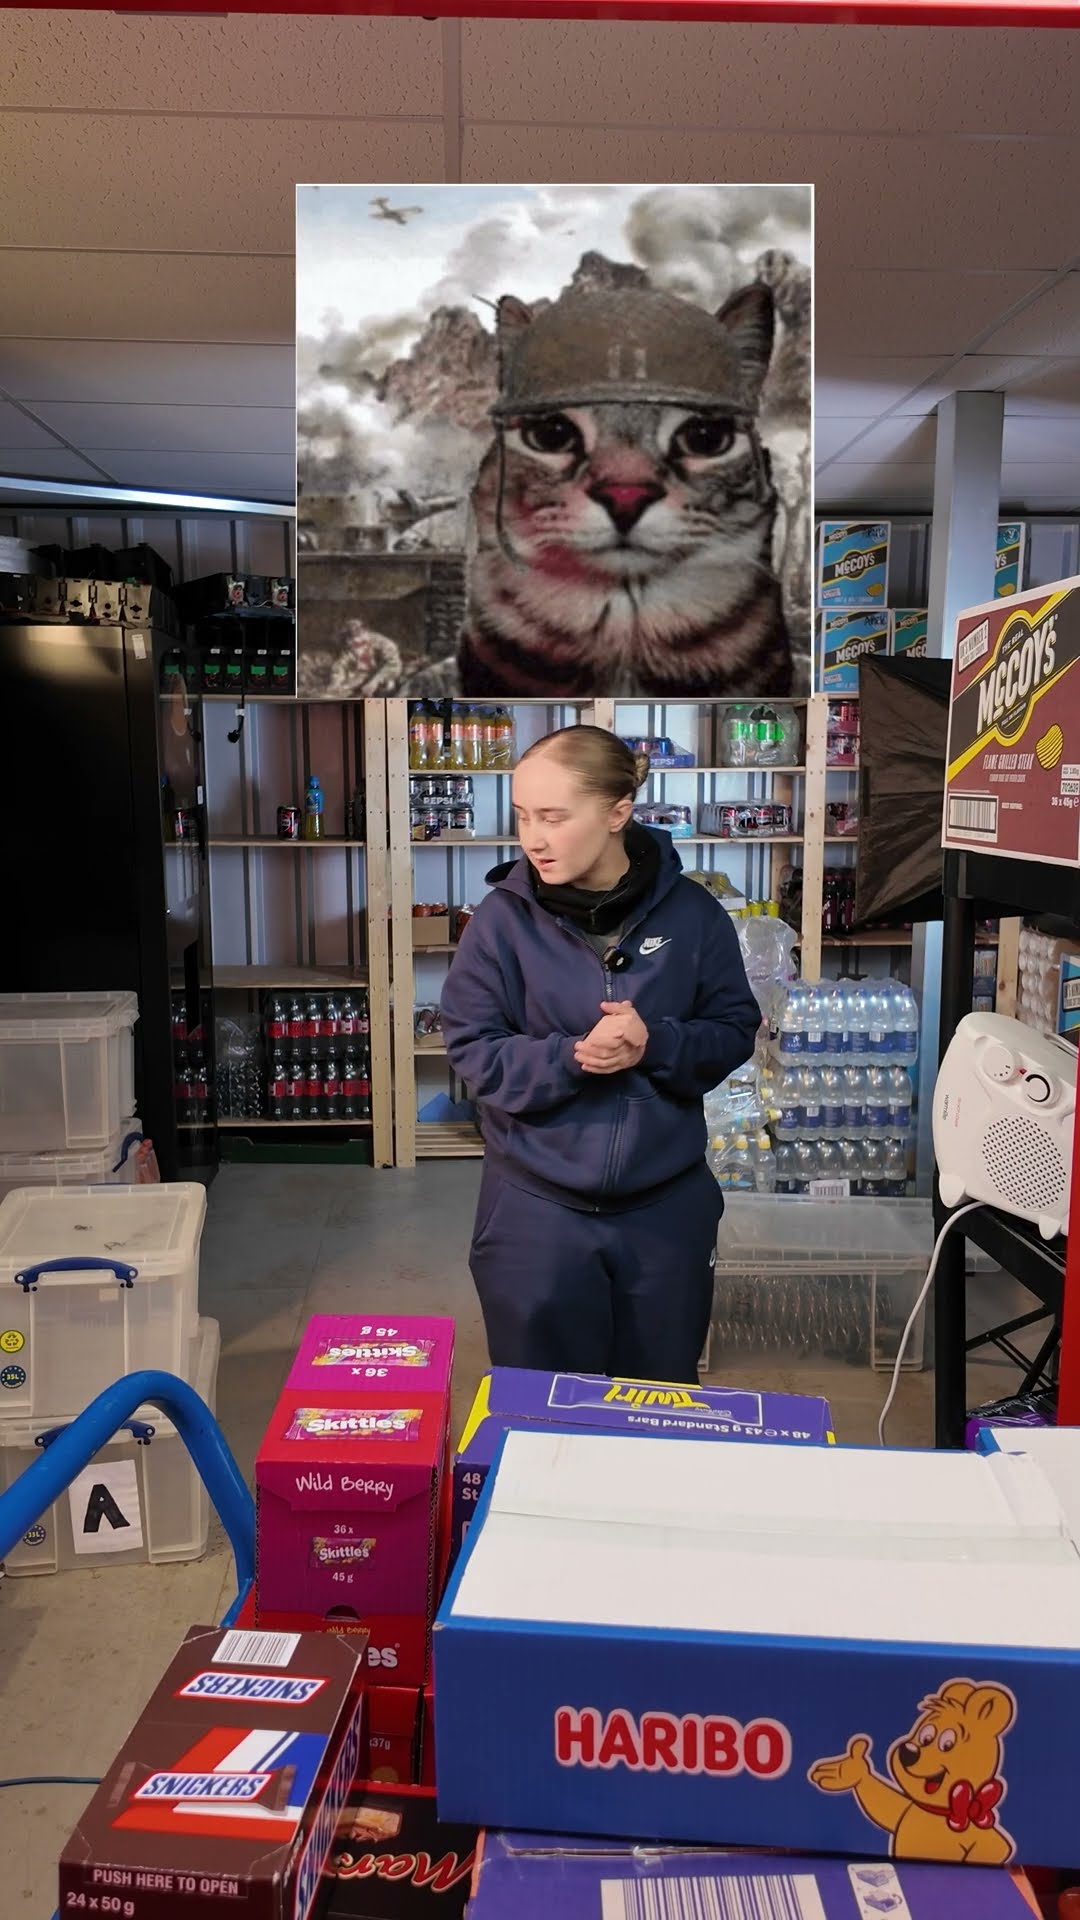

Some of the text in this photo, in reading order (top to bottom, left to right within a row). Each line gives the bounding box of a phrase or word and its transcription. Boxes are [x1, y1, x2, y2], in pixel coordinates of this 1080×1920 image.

[1002, 629, 1024, 655] THE REAL
[982, 754, 1034, 770] FLAME GRILLED STEAK
[423, 797, 453, 805] PEPSI
[643, 936, 663, 948] NIKE
[360, 1326, 398, 1337] 45 g
[329, 1346, 418, 1358] Skittles
[365, 1368, 388, 1377] 36
[603, 1384, 711, 1409] Twirl
[306, 1417, 406, 1433] Skittles
[627, 1415, 660, 1427] Bars
[662, 1418, 730, 1434] Standard
[732, 1425, 742, 1433] g
[780, 1429, 790, 1437] x
[792, 1431, 811, 1439] 48
[296, 1472, 332, 1492] Wild
[462, 1472, 481, 1485] 48
[83, 1484, 131, 1533] A
[334, 1524, 346, 1534] 36
[319, 1546, 369, 1561] Skittles
[332, 1572, 354, 1583] 45 g
[187, 1674, 319, 1700] SNICKERS
[556, 1707, 789, 1777] HARIBO
[141, 1774, 264, 1797] SNICKERS
[93, 1868, 239, 1896] PUSH HERE TO OPEN
[67, 1891, 135, 1917] 24 x 50 g
